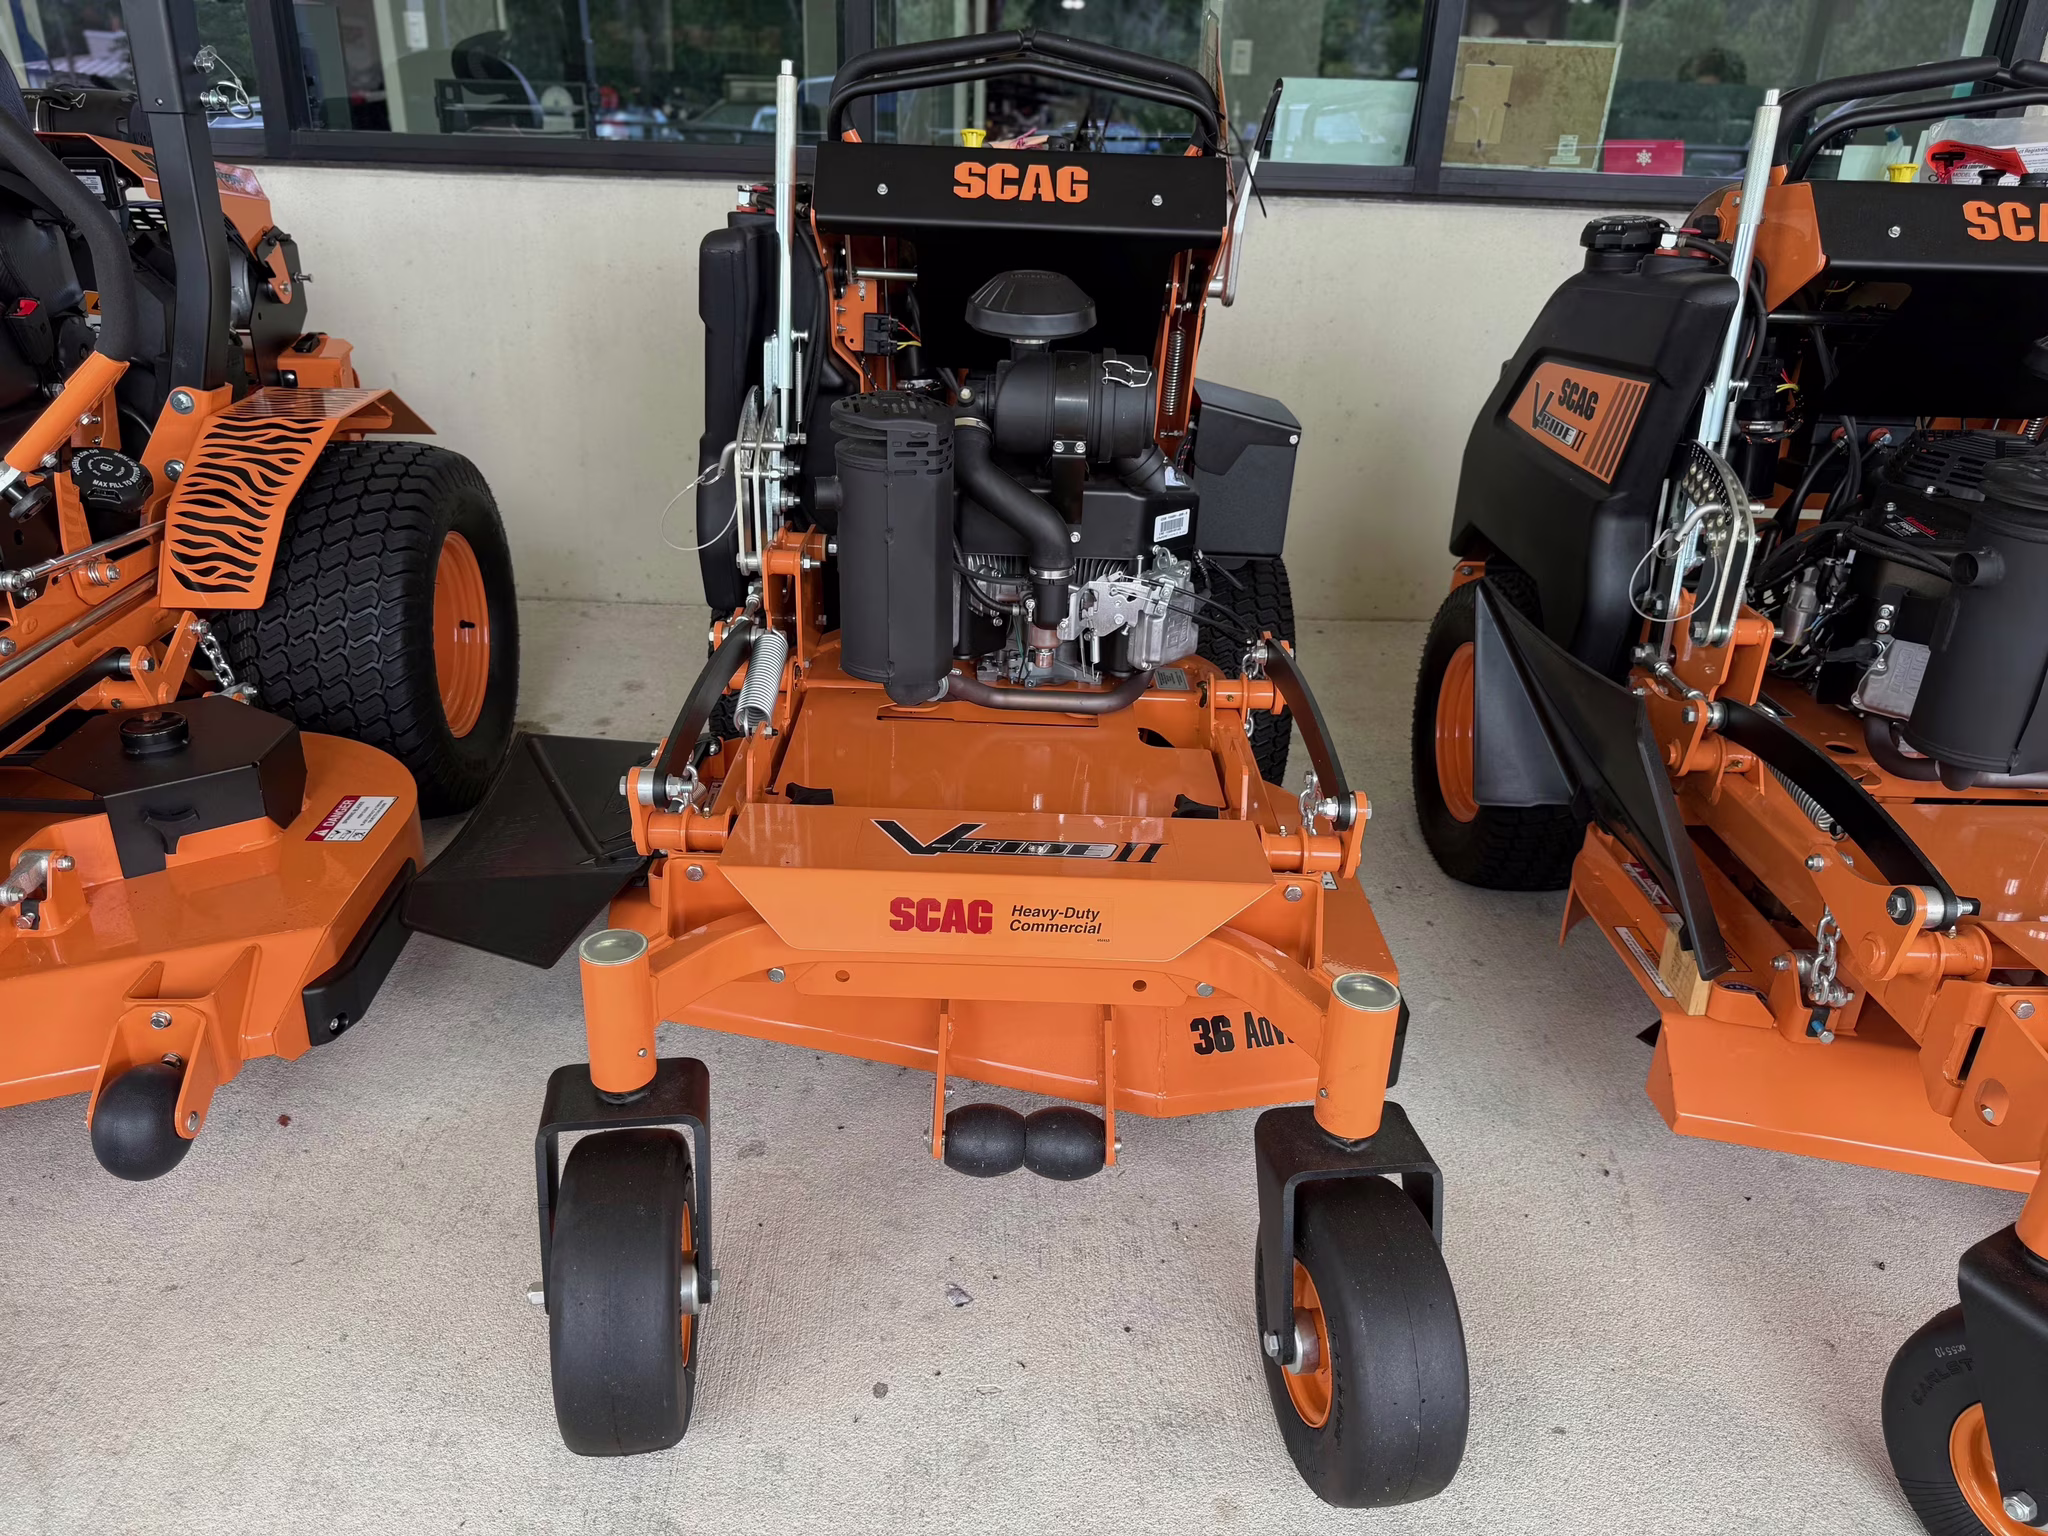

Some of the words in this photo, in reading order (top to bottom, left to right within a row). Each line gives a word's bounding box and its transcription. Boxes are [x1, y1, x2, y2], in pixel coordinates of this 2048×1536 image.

[953, 161, 1089, 203] SCAG
[1962, 200, 2048, 242] SC
[1557, 378, 1599, 421] SCAG
[92, 479, 108, 488] MAX
[322, 799, 357, 827] DANGER
[888, 896, 993, 935] SCAG
[1009, 918, 1103, 935] Commercial
[1011, 904, 1101, 923] Heavy-Duty
[1190, 1015, 1235, 1055] 36
